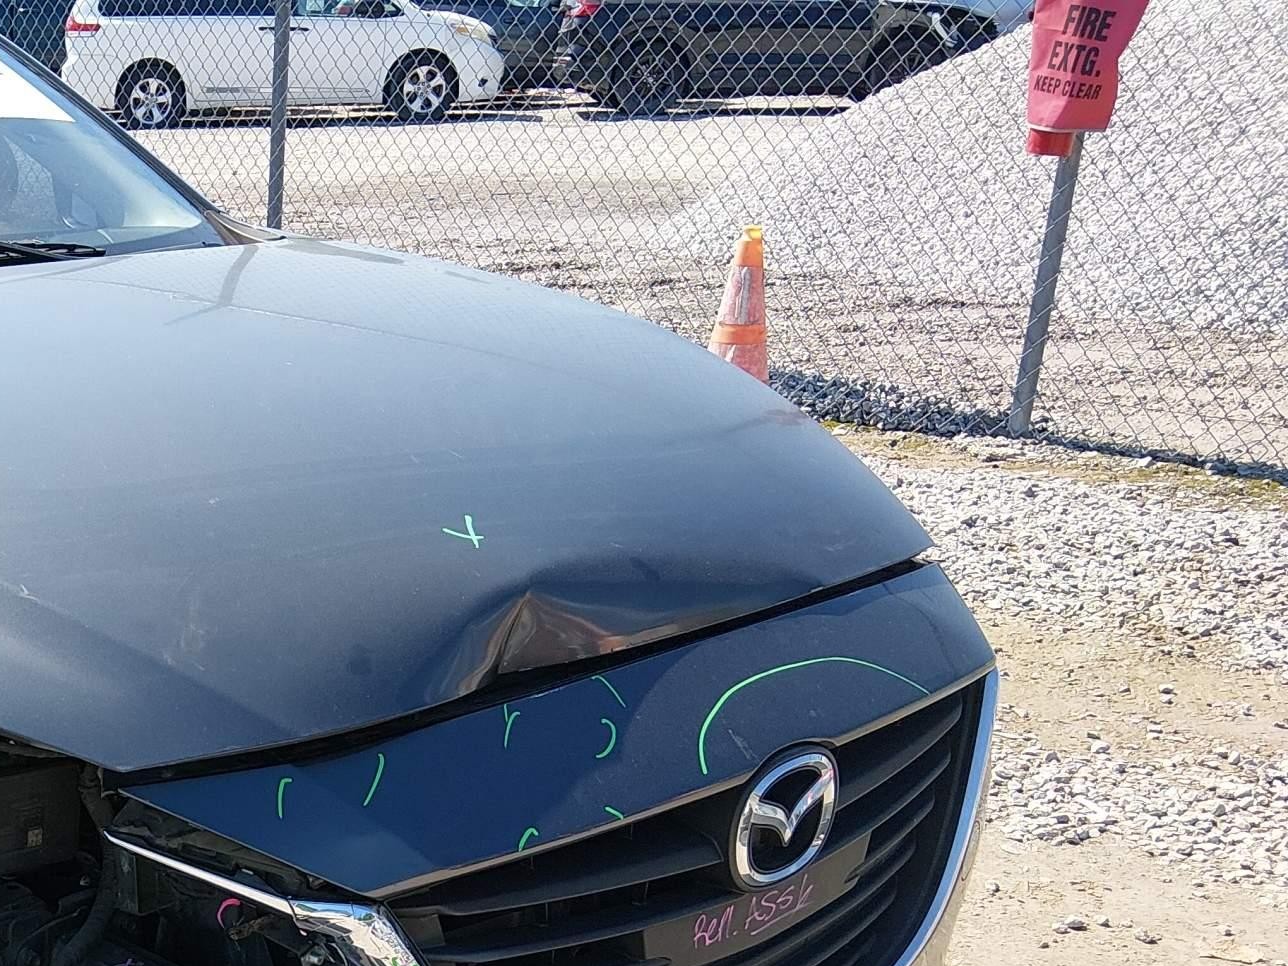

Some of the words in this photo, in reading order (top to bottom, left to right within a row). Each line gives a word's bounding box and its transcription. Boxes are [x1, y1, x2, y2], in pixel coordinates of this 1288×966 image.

[1062, 4, 1117, 42] FIRE
[1047, 40, 1101, 77] EXTG.
[1033, 75, 1062, 93] KEEP
[1062, 80, 1103, 100] CLEAR
